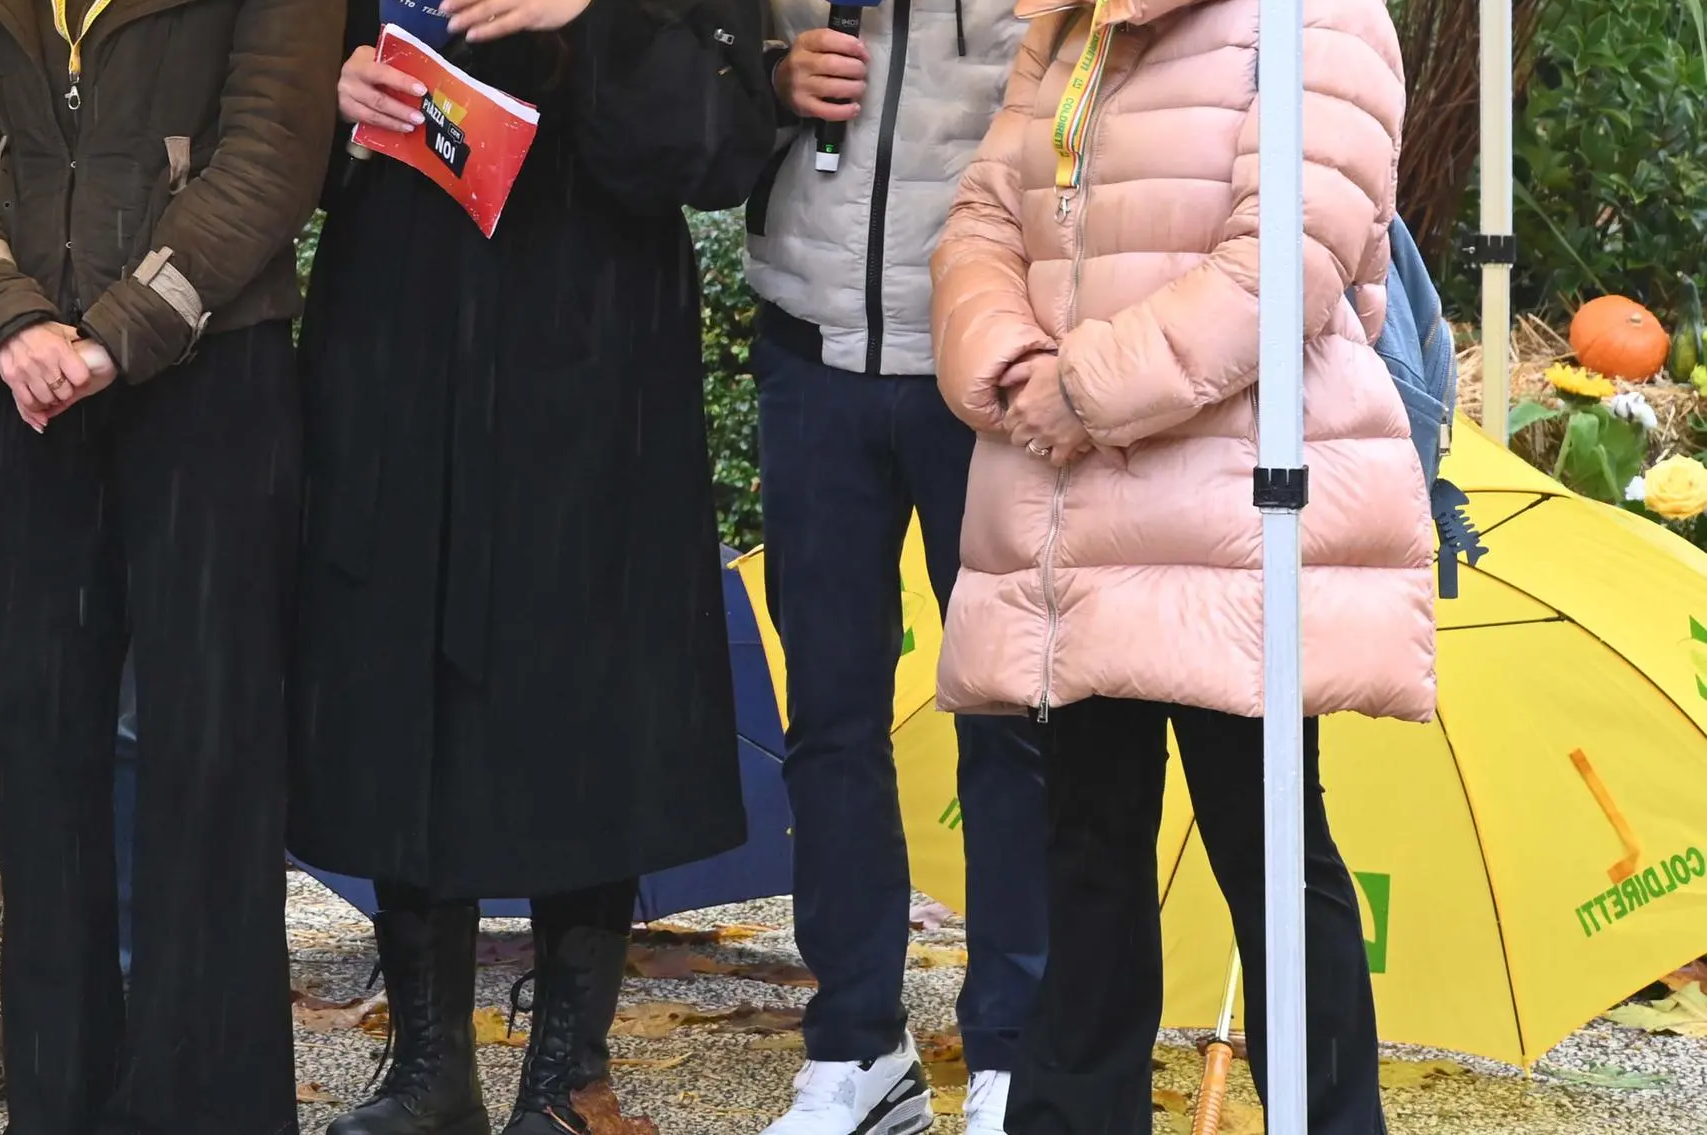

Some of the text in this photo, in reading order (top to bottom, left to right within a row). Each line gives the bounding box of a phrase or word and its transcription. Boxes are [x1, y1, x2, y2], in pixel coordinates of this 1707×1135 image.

[422, 98, 445, 127] PIAZZA
[442, 98, 453, 115] IN
[435, 132, 456, 164] NOI
